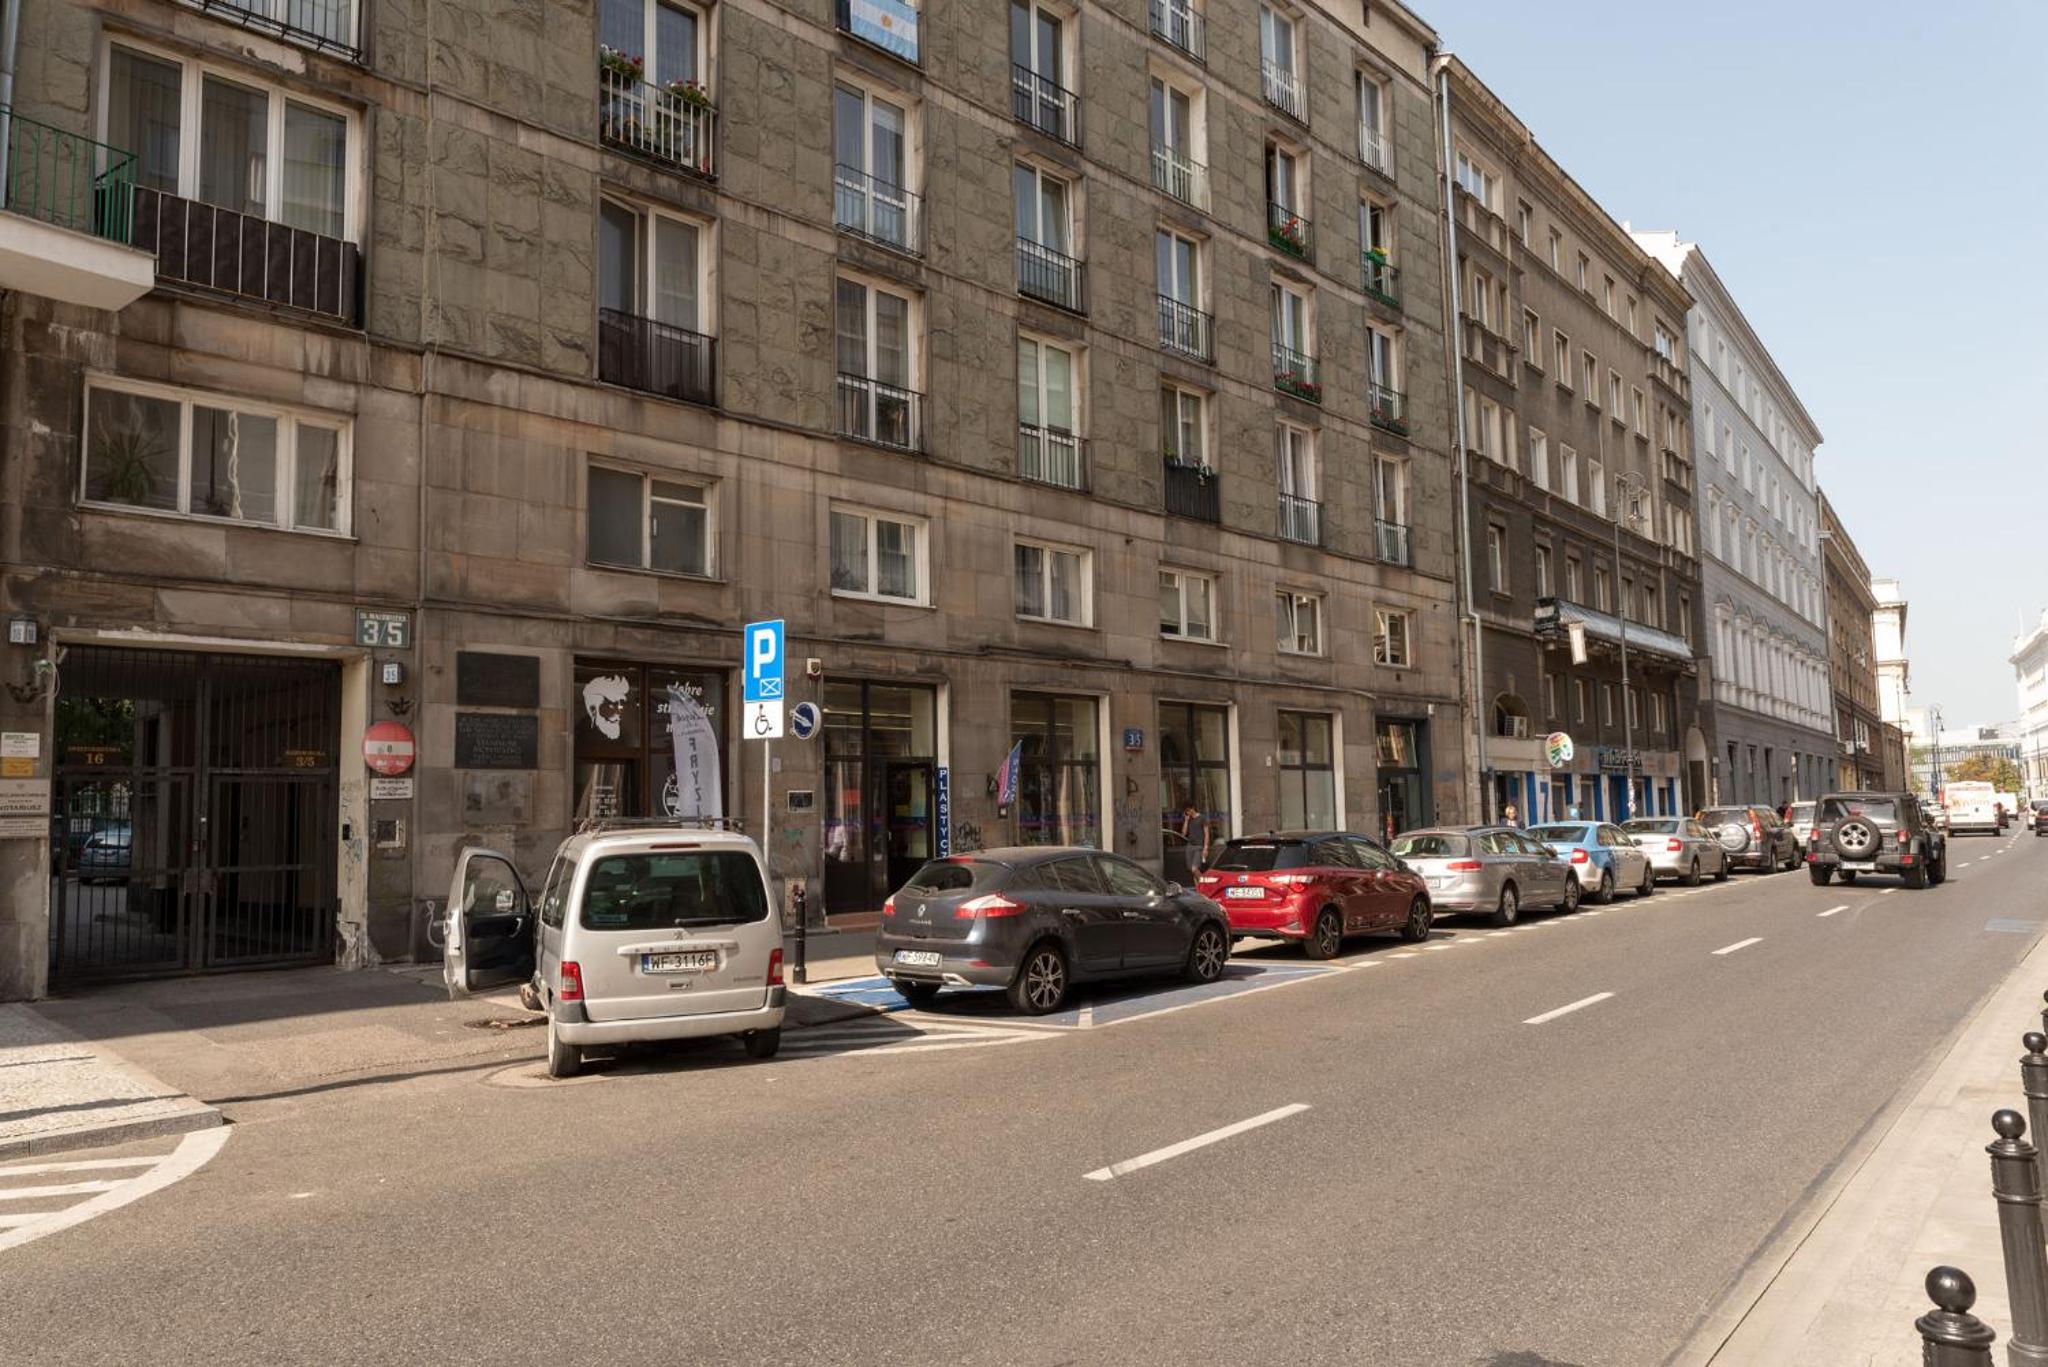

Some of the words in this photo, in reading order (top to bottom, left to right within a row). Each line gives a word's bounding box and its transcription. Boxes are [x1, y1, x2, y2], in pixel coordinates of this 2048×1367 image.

[363, 620, 402, 645] 3/5
[753, 628, 777, 679] P
[87, 753, 105, 765] 16
